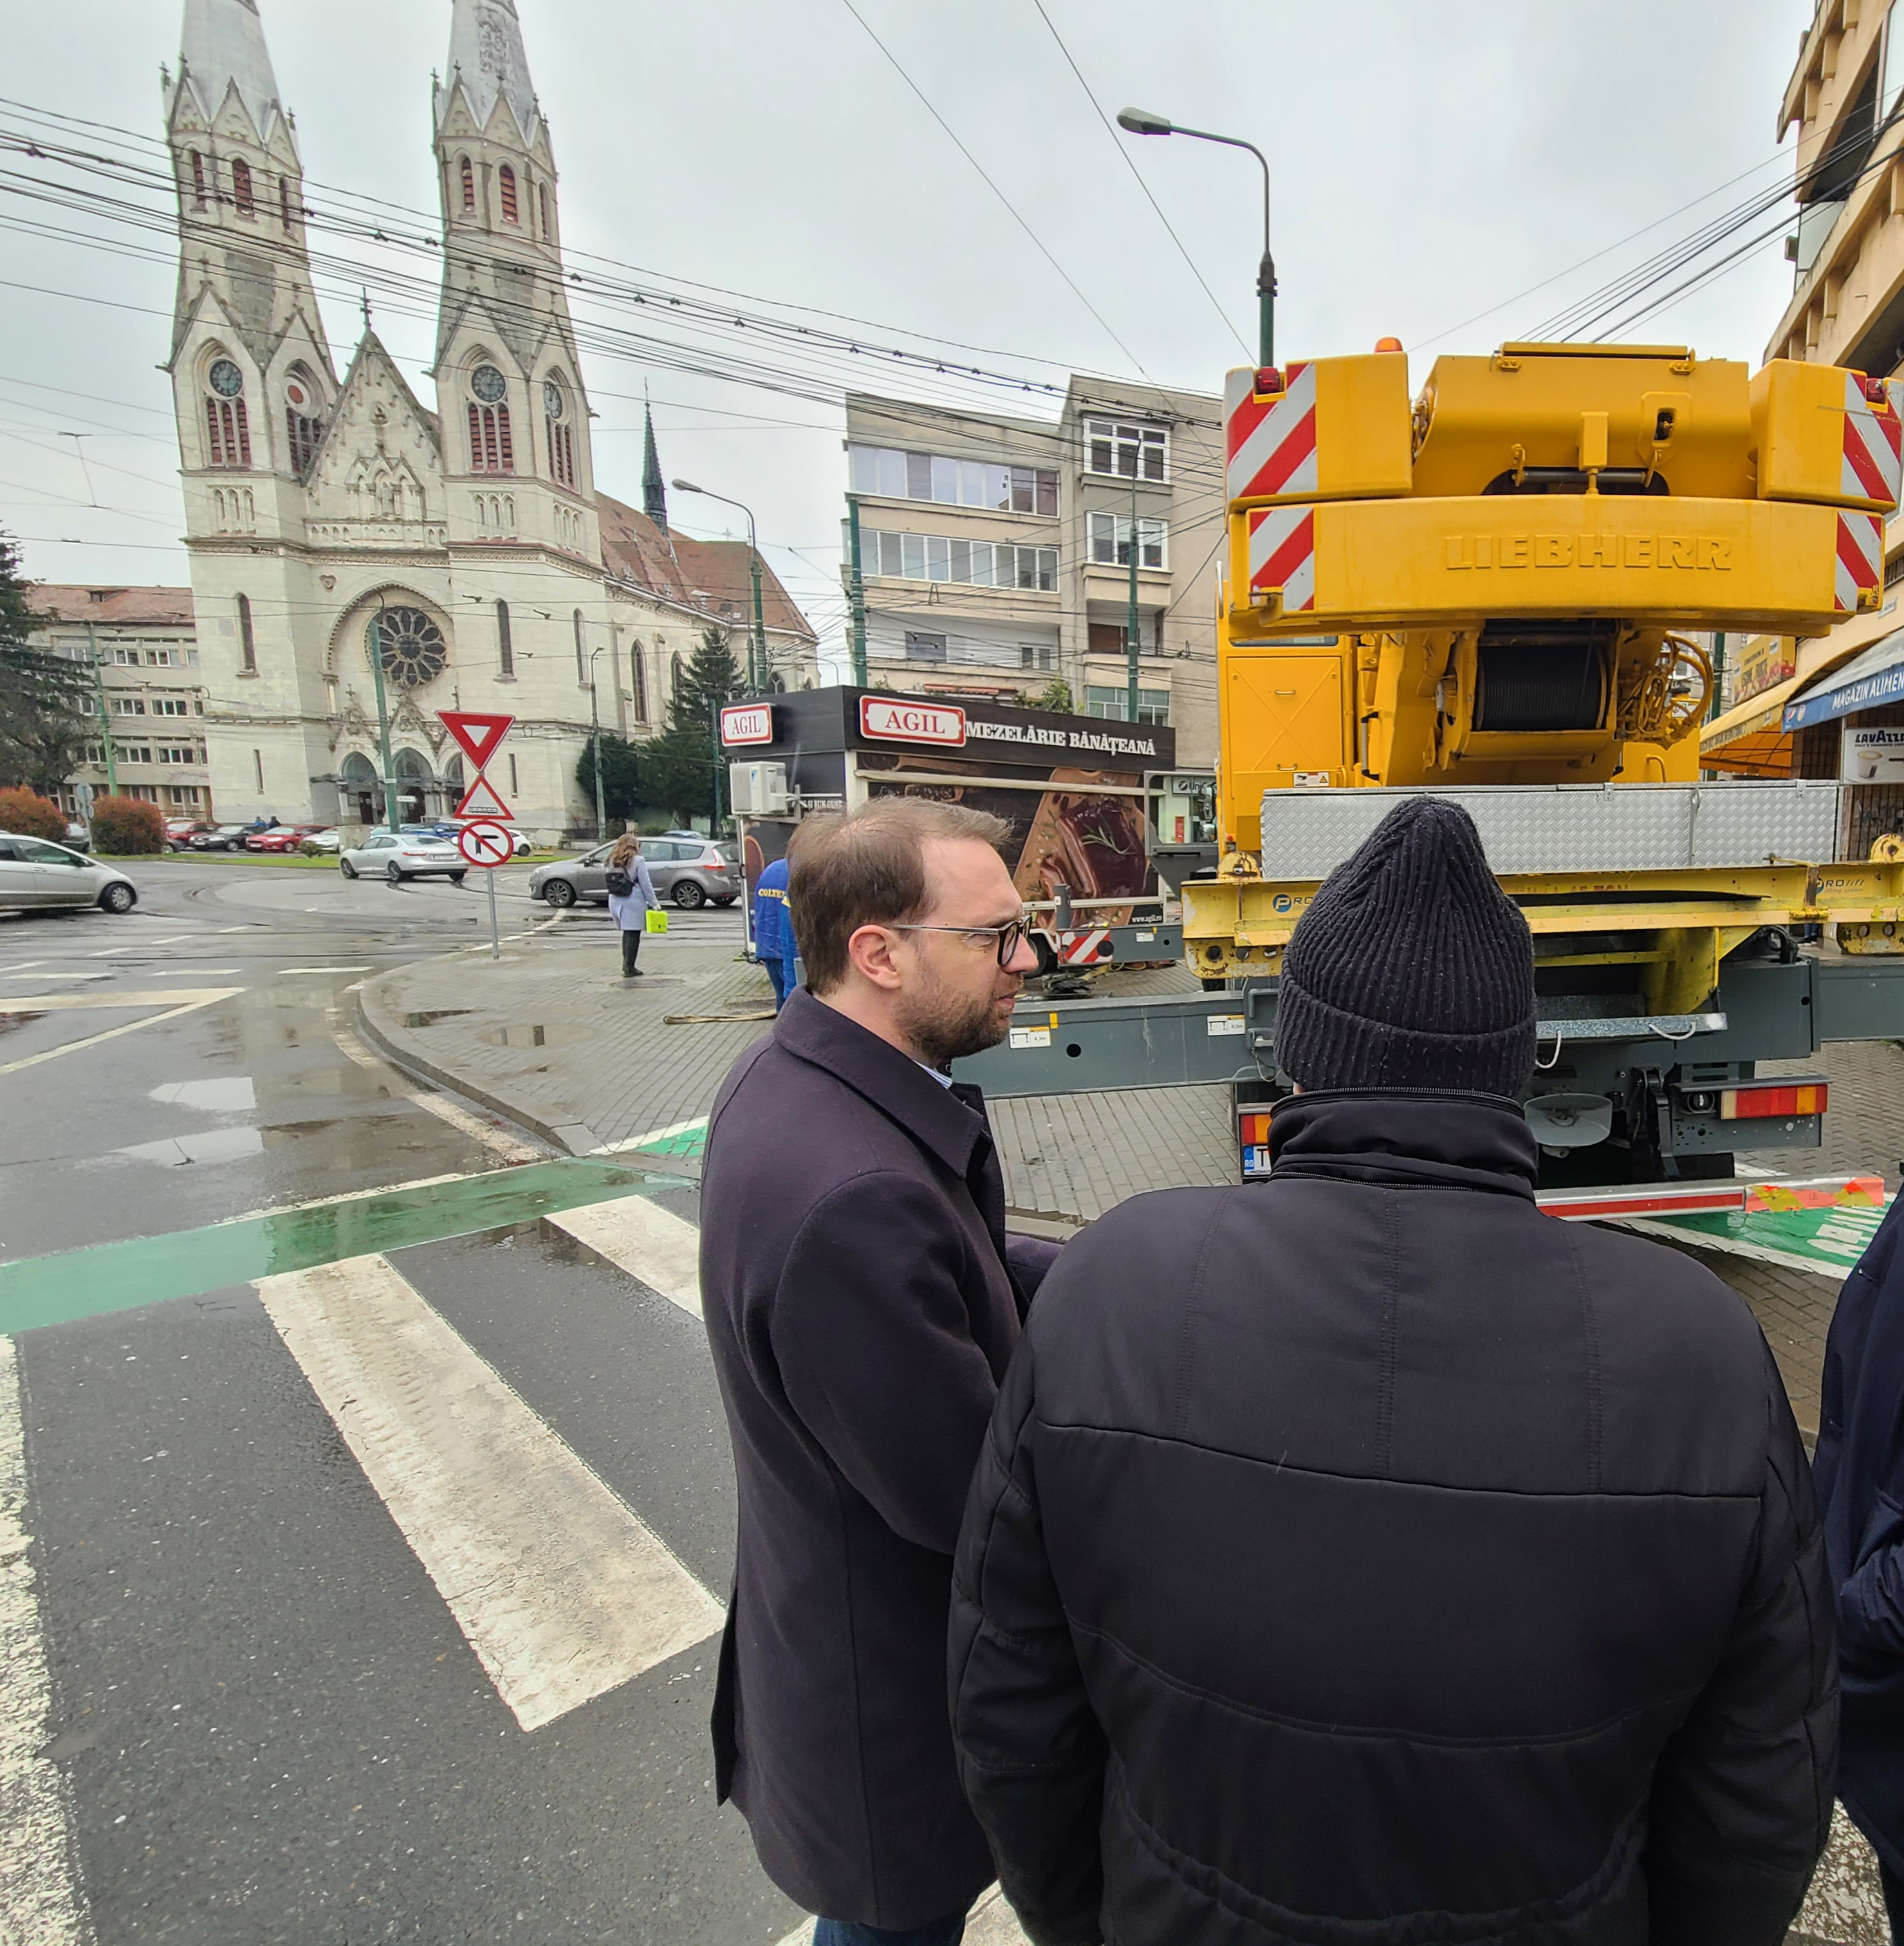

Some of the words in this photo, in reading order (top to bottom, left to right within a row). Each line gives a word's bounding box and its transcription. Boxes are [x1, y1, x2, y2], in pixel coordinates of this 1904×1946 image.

[1446, 535, 1732, 571] LIEBHERR
[1833, 682, 1867, 709] MAGAZIN
[732, 715, 761, 735] AGIL
[885, 710, 945, 734] AGIL
[965, 721, 1066, 746] MEZELĂRIE
